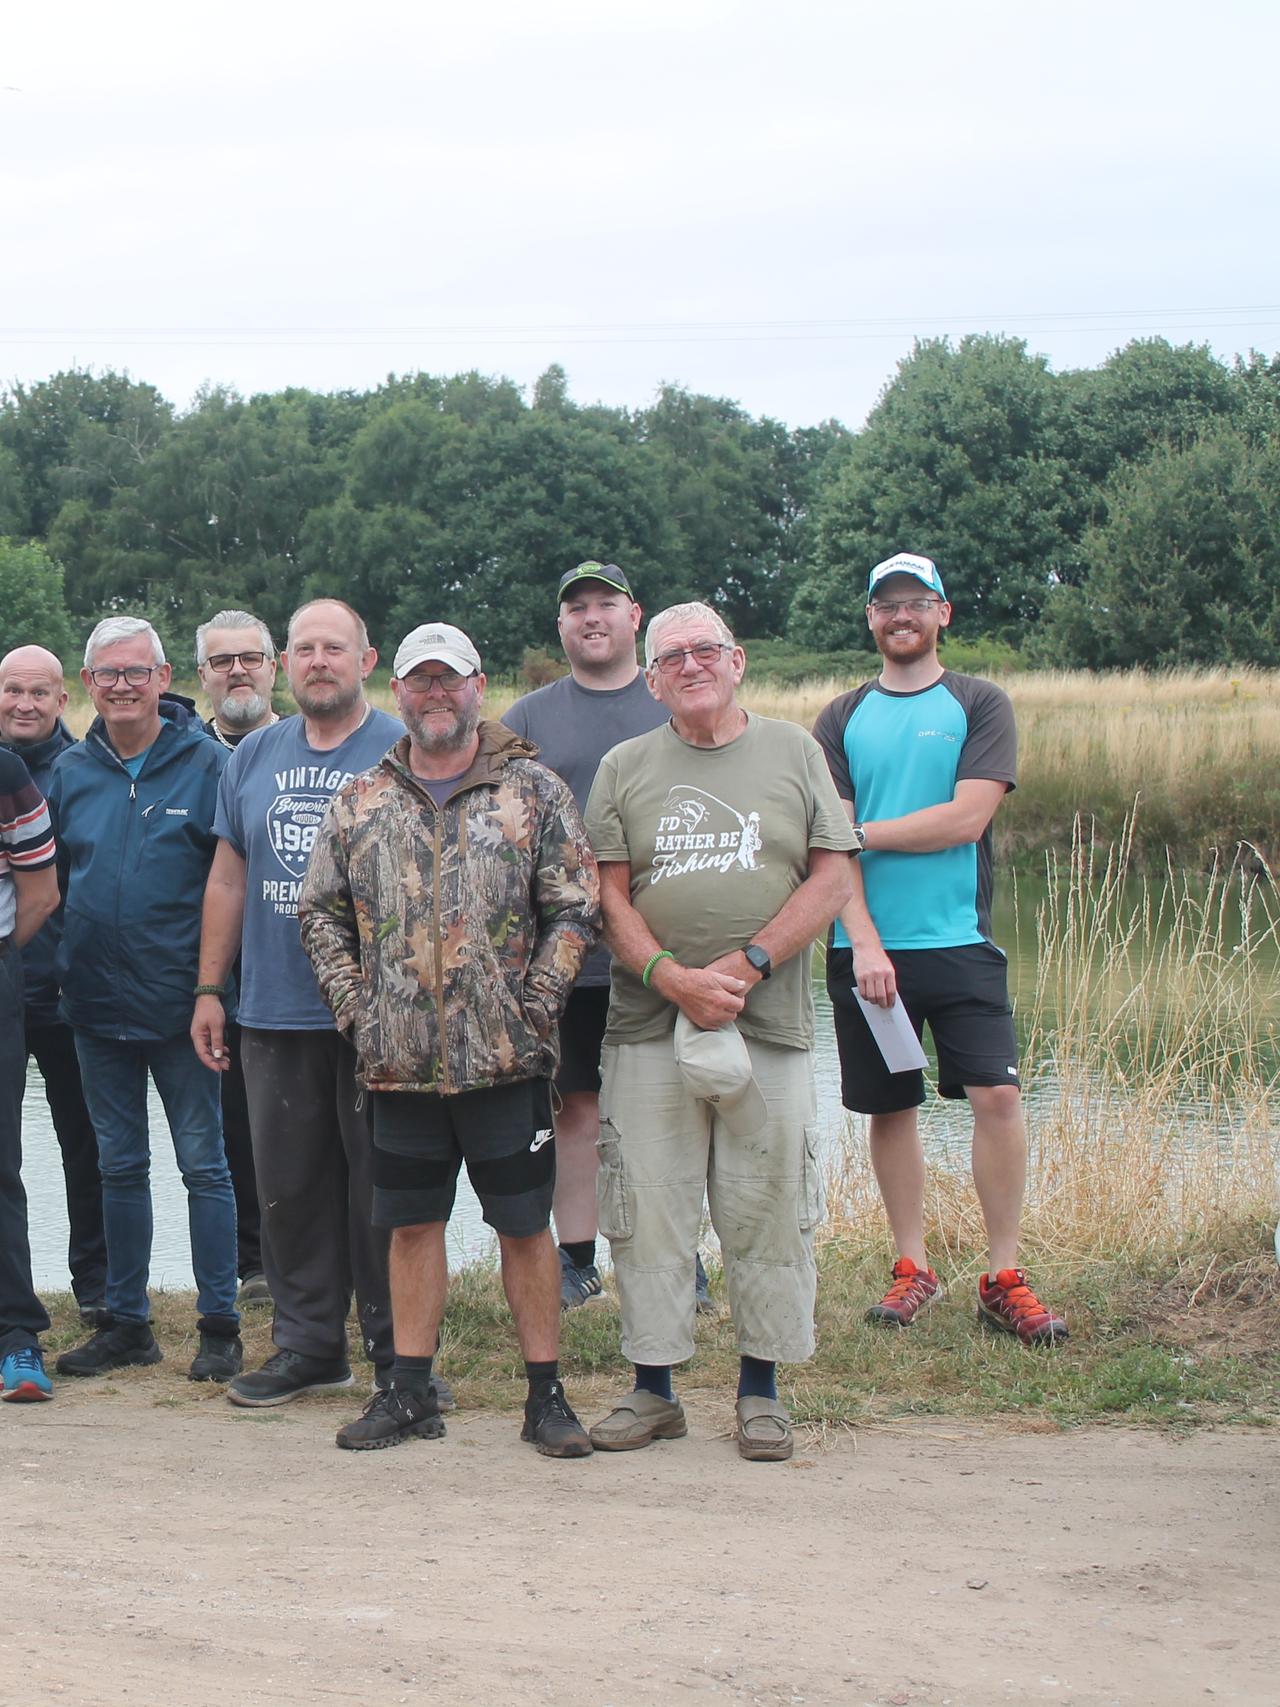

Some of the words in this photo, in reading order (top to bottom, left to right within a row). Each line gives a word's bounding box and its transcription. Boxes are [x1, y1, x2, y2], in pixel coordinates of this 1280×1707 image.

[275, 766, 354, 791] VINTAGE
[274, 797, 329, 816] Superio
[657, 816, 680, 832] I'D
[272, 820, 319, 853] 198
[654, 833, 716, 852] RATHER
[718, 831, 741, 848] BE
[651, 851, 737, 885] Fishing
[262, 880, 303, 902] PREM
[274, 903, 299, 915] PROD
